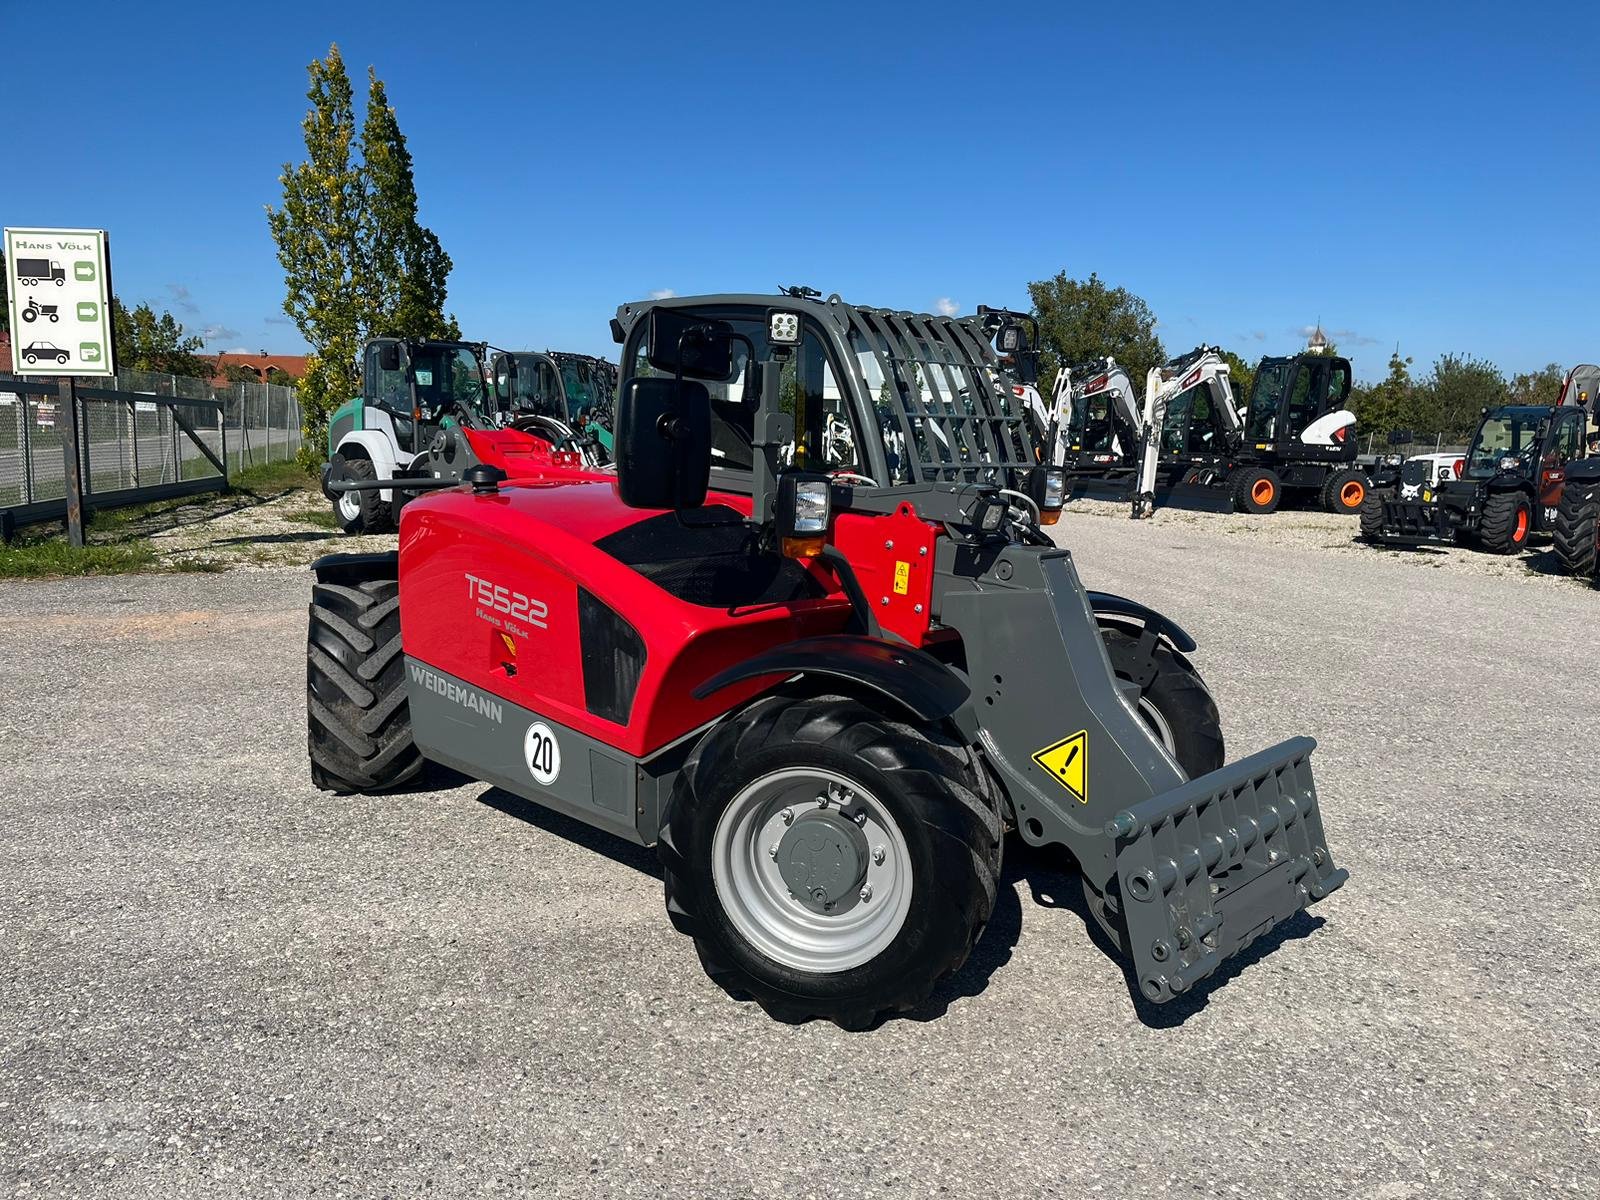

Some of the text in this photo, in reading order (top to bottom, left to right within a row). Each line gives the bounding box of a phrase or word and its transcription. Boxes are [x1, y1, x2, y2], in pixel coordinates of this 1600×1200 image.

[16, 240, 92, 251] HANS VÖLK
[464, 572, 548, 630] T5522
[475, 607, 501, 627] HANS
[410, 664, 503, 724] WEIDEMANN
[532, 731, 553, 775] 20
